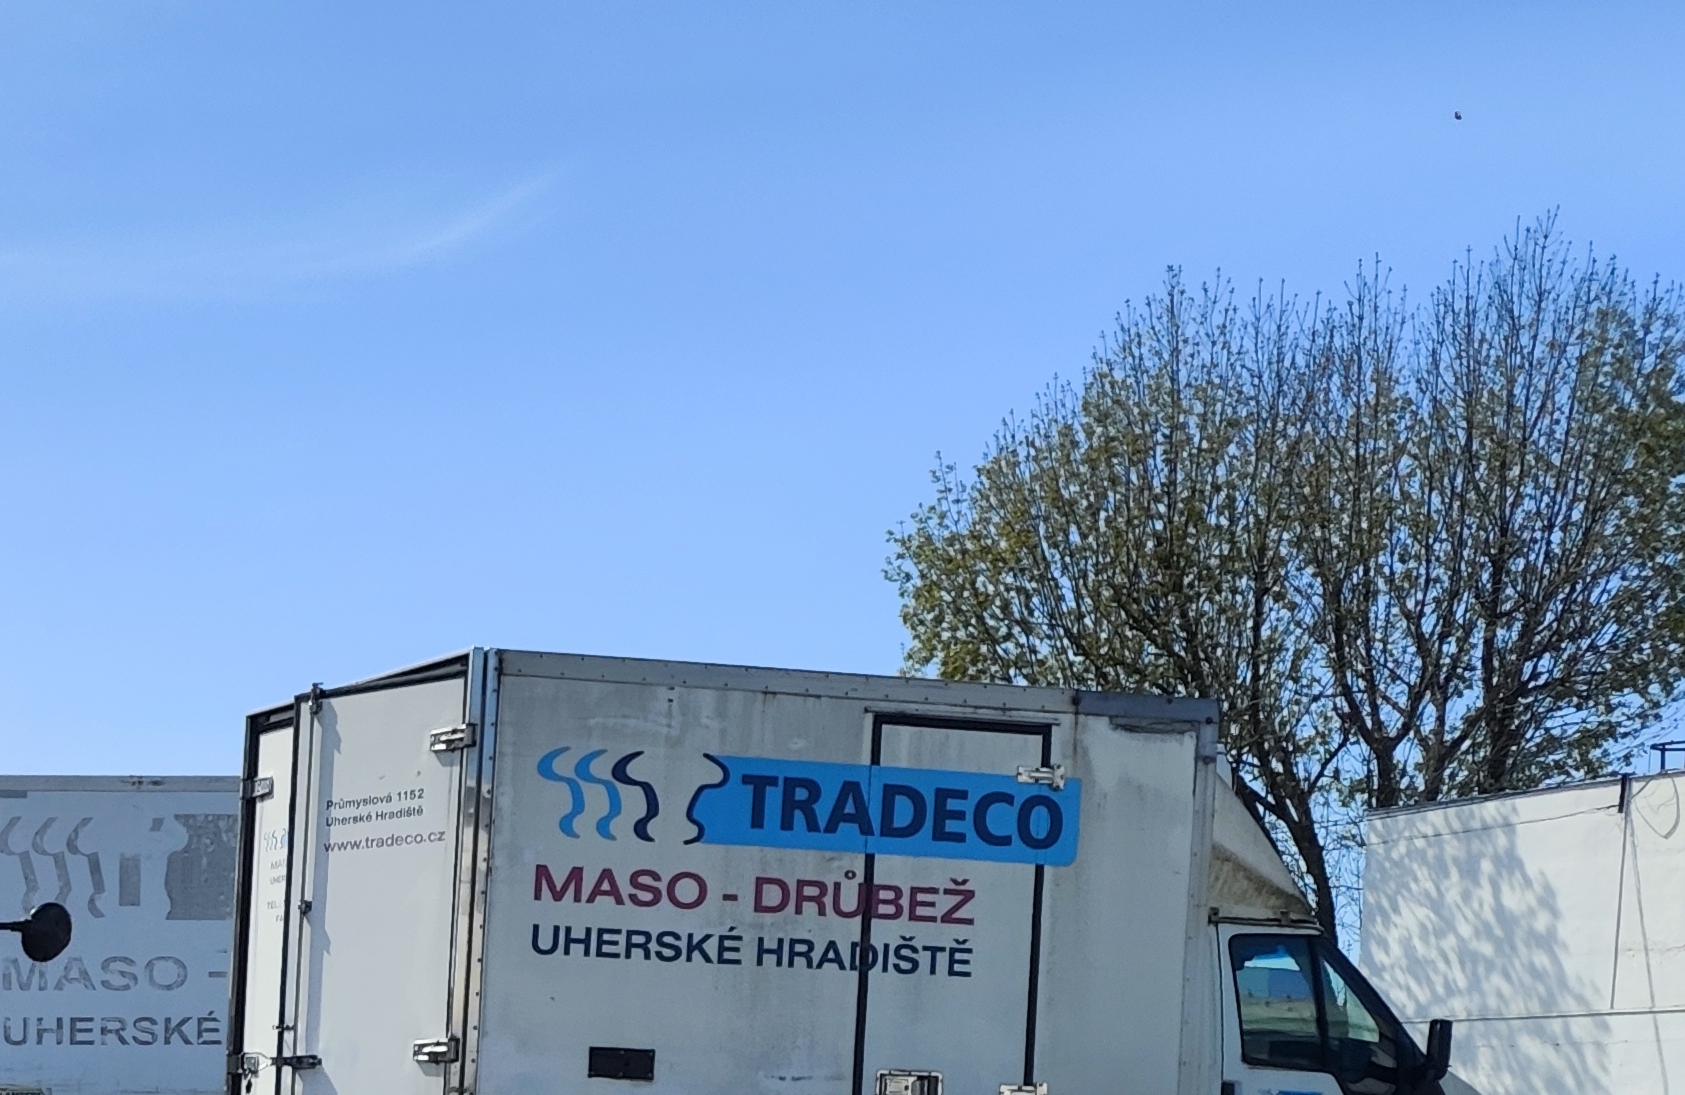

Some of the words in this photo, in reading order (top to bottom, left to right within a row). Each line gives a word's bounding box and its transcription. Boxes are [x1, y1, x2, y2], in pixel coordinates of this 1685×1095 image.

[325, 811, 373, 828] Uherské
[375, 804, 424, 822] Hradiště
[326, 792, 393, 811] Průmyslová
[396, 788, 426, 803] 1152
[741, 773, 1065, 851] TRADECO
[323, 830, 447, 853] www.tradeco.cz
[533, 863, 709, 911] MASO
[753, 869, 976, 926] DRŮBEŽ
[531, 923, 744, 966] UHERSKÉ
[756, 935, 975, 978] HRADIŠTĚ
[1, 955, 189, 992] MASO
[2, 1010, 224, 1047] UHERSKÉ
